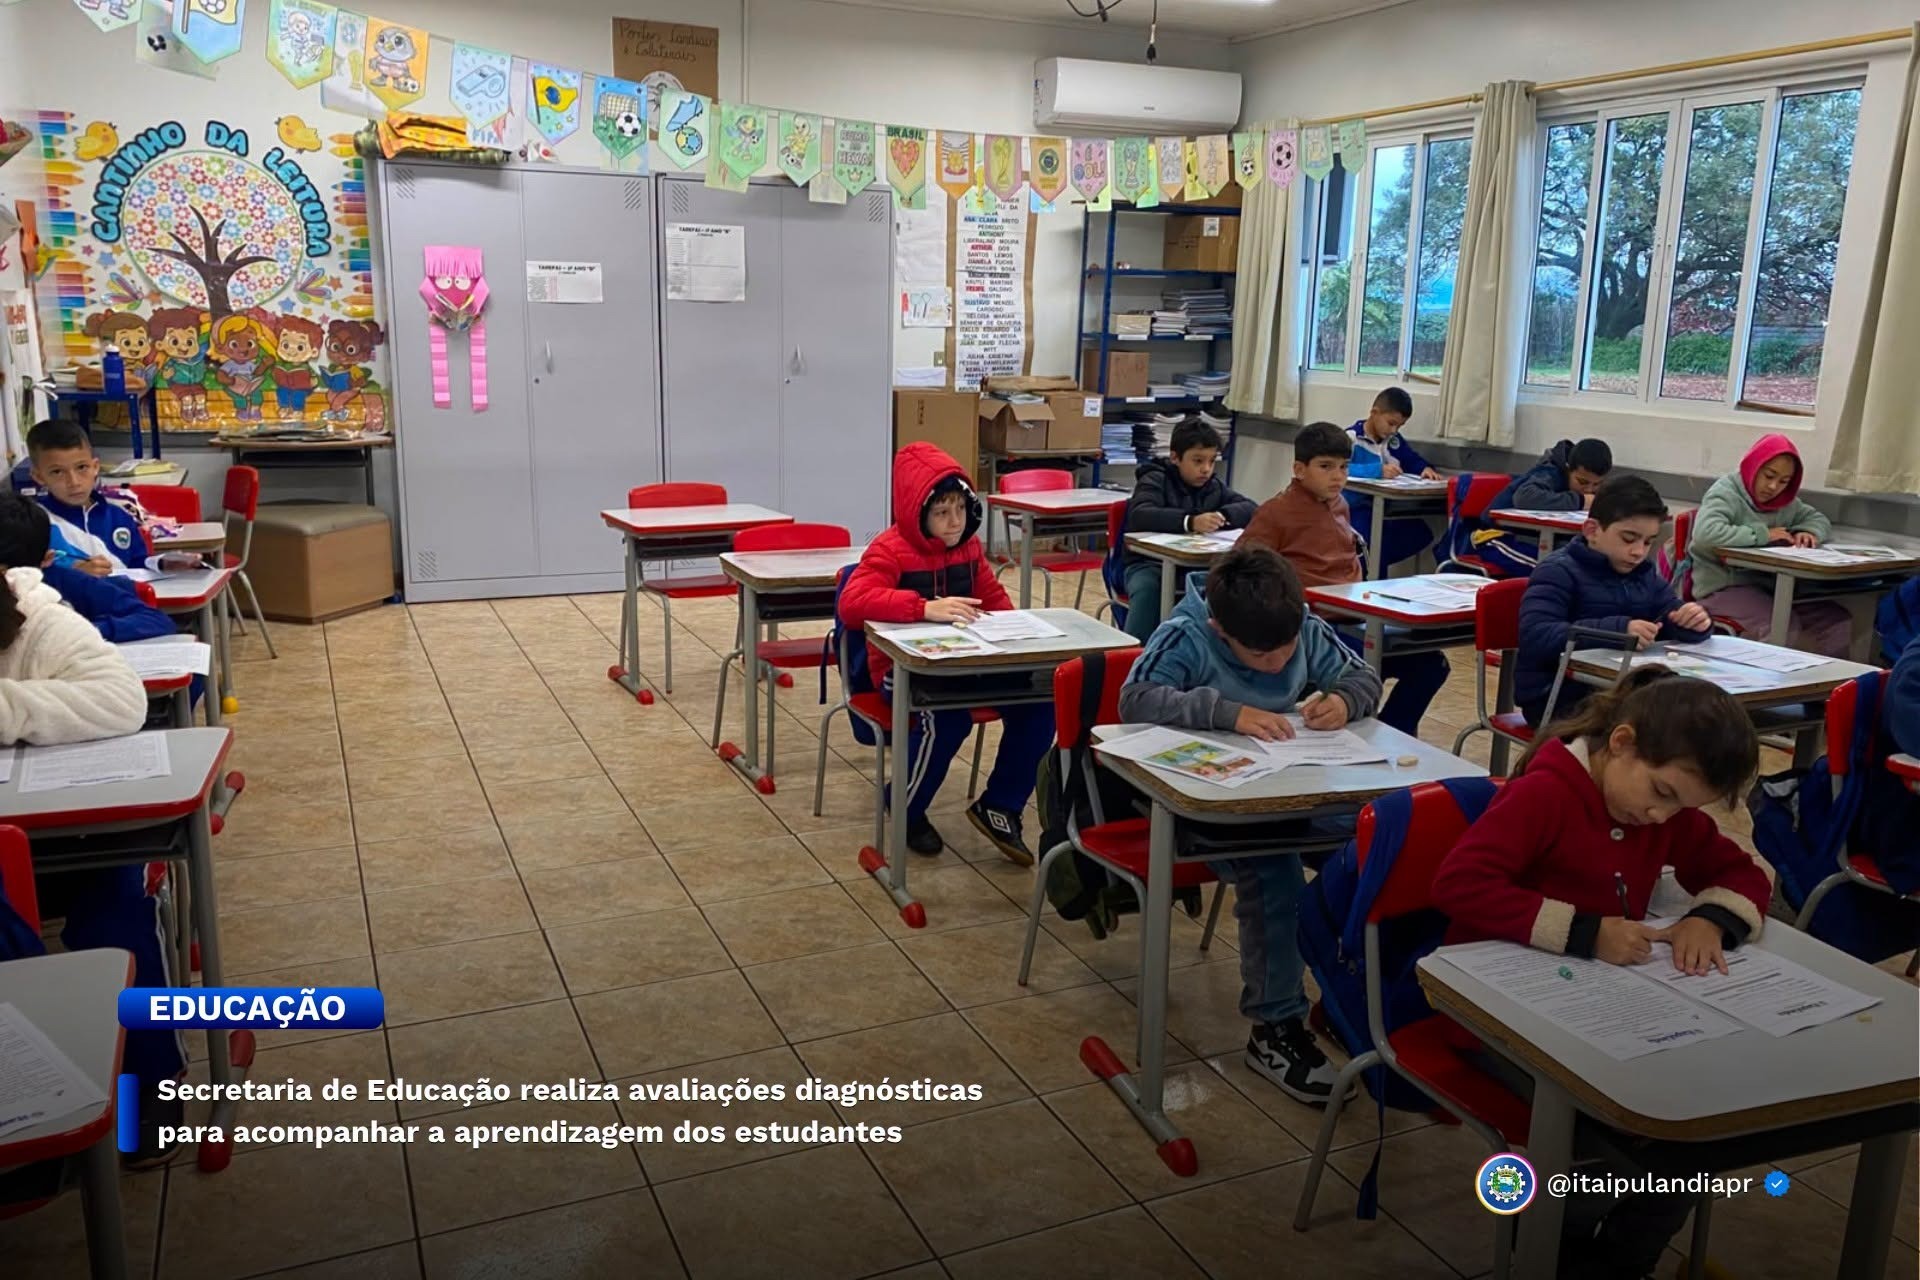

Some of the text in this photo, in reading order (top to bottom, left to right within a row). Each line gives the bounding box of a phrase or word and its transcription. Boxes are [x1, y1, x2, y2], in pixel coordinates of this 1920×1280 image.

[840, 129, 870, 142] RUMO
[887, 125, 925, 141] BRASIL
[91, 120, 331, 258] CANTINHO DA LEITURA
